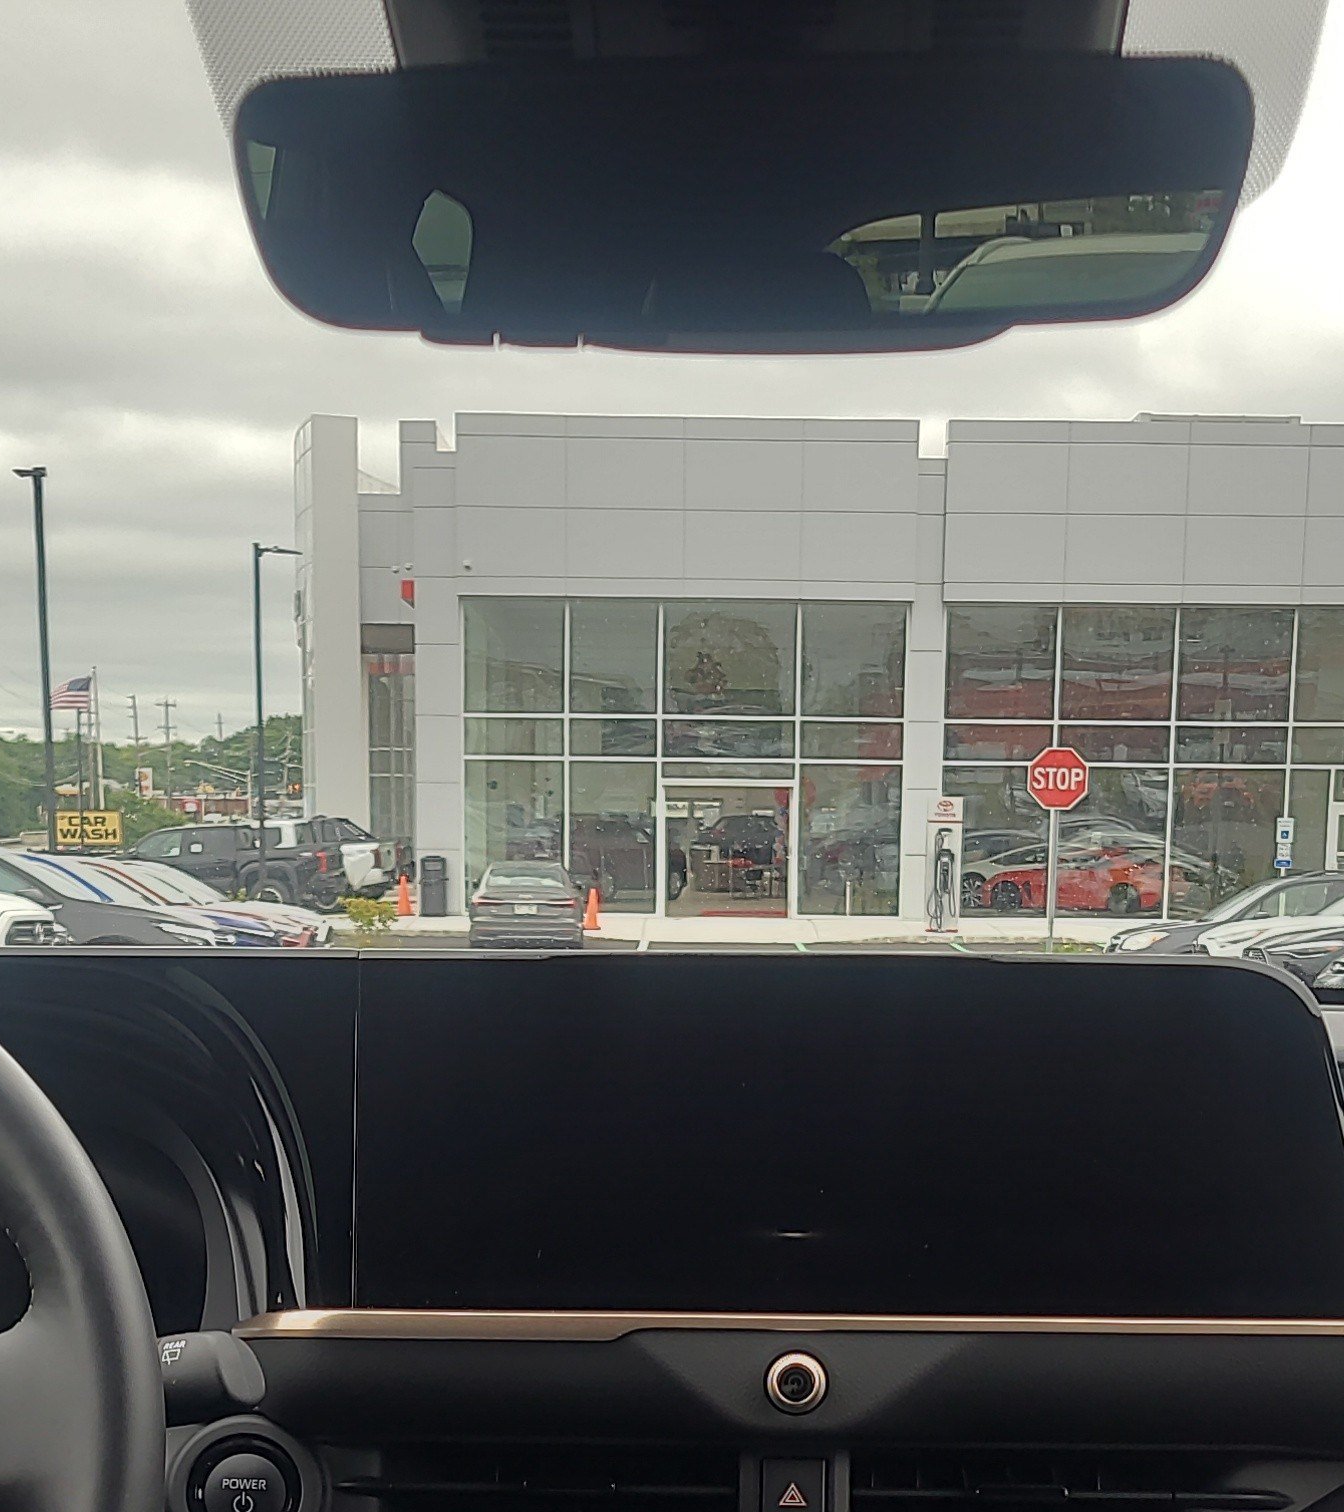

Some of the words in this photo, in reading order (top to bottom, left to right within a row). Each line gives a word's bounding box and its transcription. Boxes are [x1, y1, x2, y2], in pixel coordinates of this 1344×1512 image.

[1032, 766, 1084, 791] STOP
[68, 816, 107, 827] CAR
[59, 828, 118, 840] WASH
[163, 1340, 186, 1350] REAR
[221, 1477, 267, 1491] POWER
